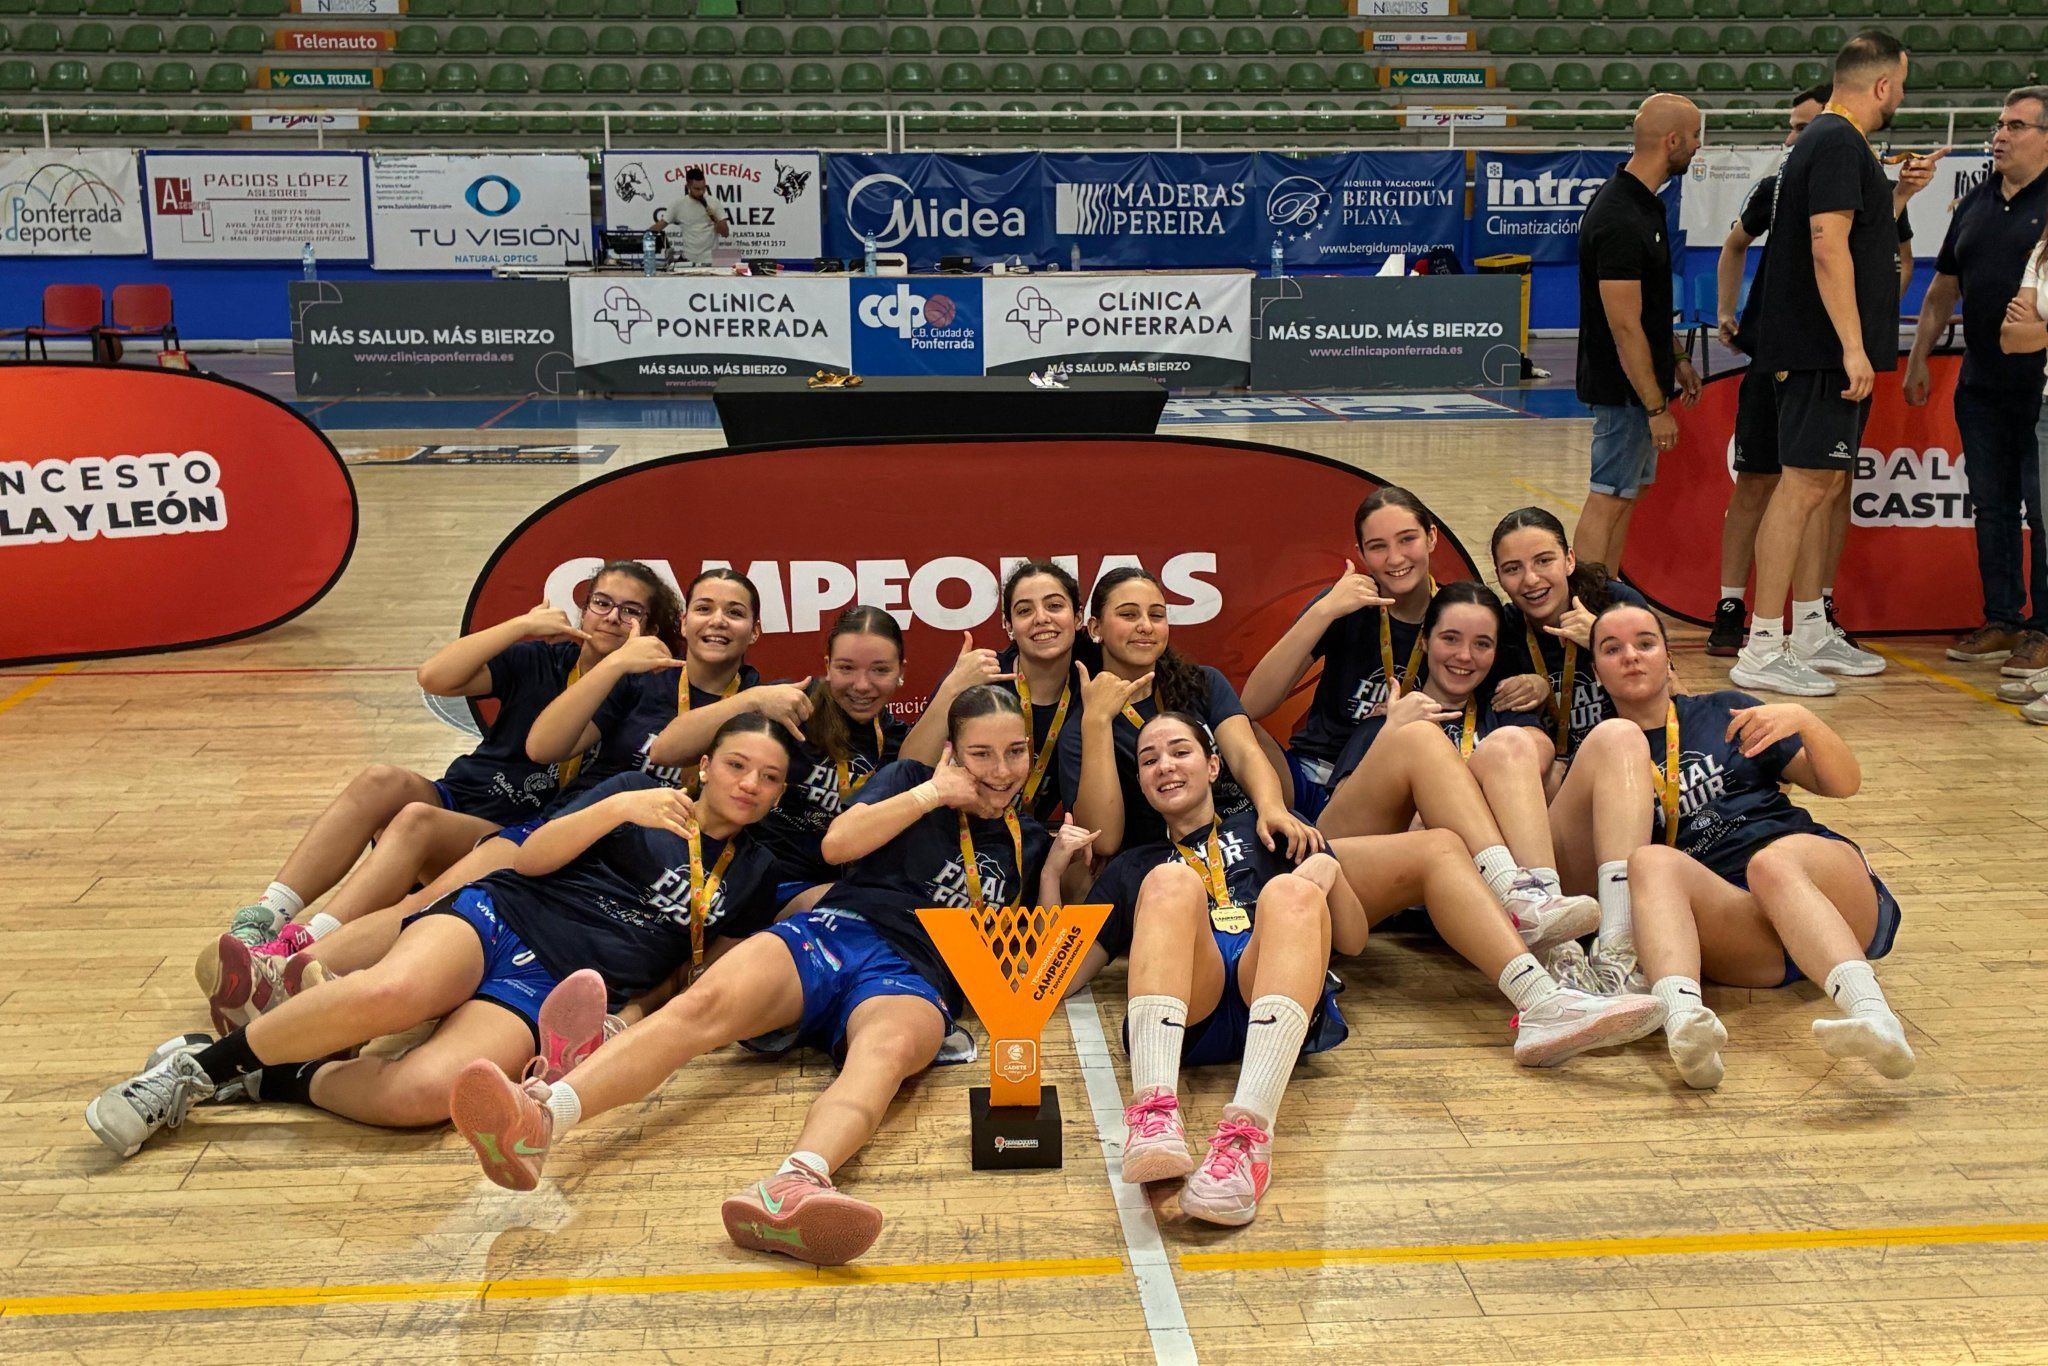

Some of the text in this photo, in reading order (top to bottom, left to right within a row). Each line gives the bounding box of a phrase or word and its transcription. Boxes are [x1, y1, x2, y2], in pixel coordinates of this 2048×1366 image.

[293, 34, 377, 49] Telenauto
[293, 74, 371, 86] CAJA RURAL
[1411, 73, 1483, 84] CAJA RURAL
[204, 172, 349, 187] PACIOS LÓPEZ
[1344, 179, 1435, 188] ALQUILER VACACIONAL
[247, 189, 308, 198] ASESORES
[1112, 183, 1246, 207] MADERAS
[1342, 190, 1454, 206] BERGIDUM
[13, 197, 122, 224] Ponferrada
[882, 198, 1026, 239] Midea
[1342, 209, 1402, 226] PLAYA
[1112, 211, 1226, 235] PEREIRA
[1486, 216, 1578, 235] Climatización
[5, 224, 91, 247] deporte
[410, 224, 580, 246] TU VISIÓN
[455, 254, 538, 264] NATURAL OPTICS
[657, 318, 828, 338] PONFERRADA
[911, 328, 974, 338] C.B. Ciudad de
[1067, 315, 1232, 337] PONFERRADA
[1269, 320, 1503, 341] MÁS SALUD. MÁS BIERZO
[310, 325, 555, 345] MÁS SALUD. MÁS BIERZO
[911, 338, 974, 350] Ponferrada
[1309, 344, 1463, 358] www.clinicaponferrada.es
[354, 351, 514, 364] www.clinicaponferrada.es
[639, 361, 787, 375] MÁS SALUD. MÁS BIERZO
[1048, 360, 1191, 373] MÁS SALUD. MÁS BIERZO
[665, 379, 717, 388] www.clinicap
[0, 460, 211, 496] NCESTO
[64, 504, 94, 531] Y
[106, 491, 218, 529] LEÓN
[933, 860, 1006, 903] FIAL
[1033, 926, 1081, 1001] CAMPEONAS
